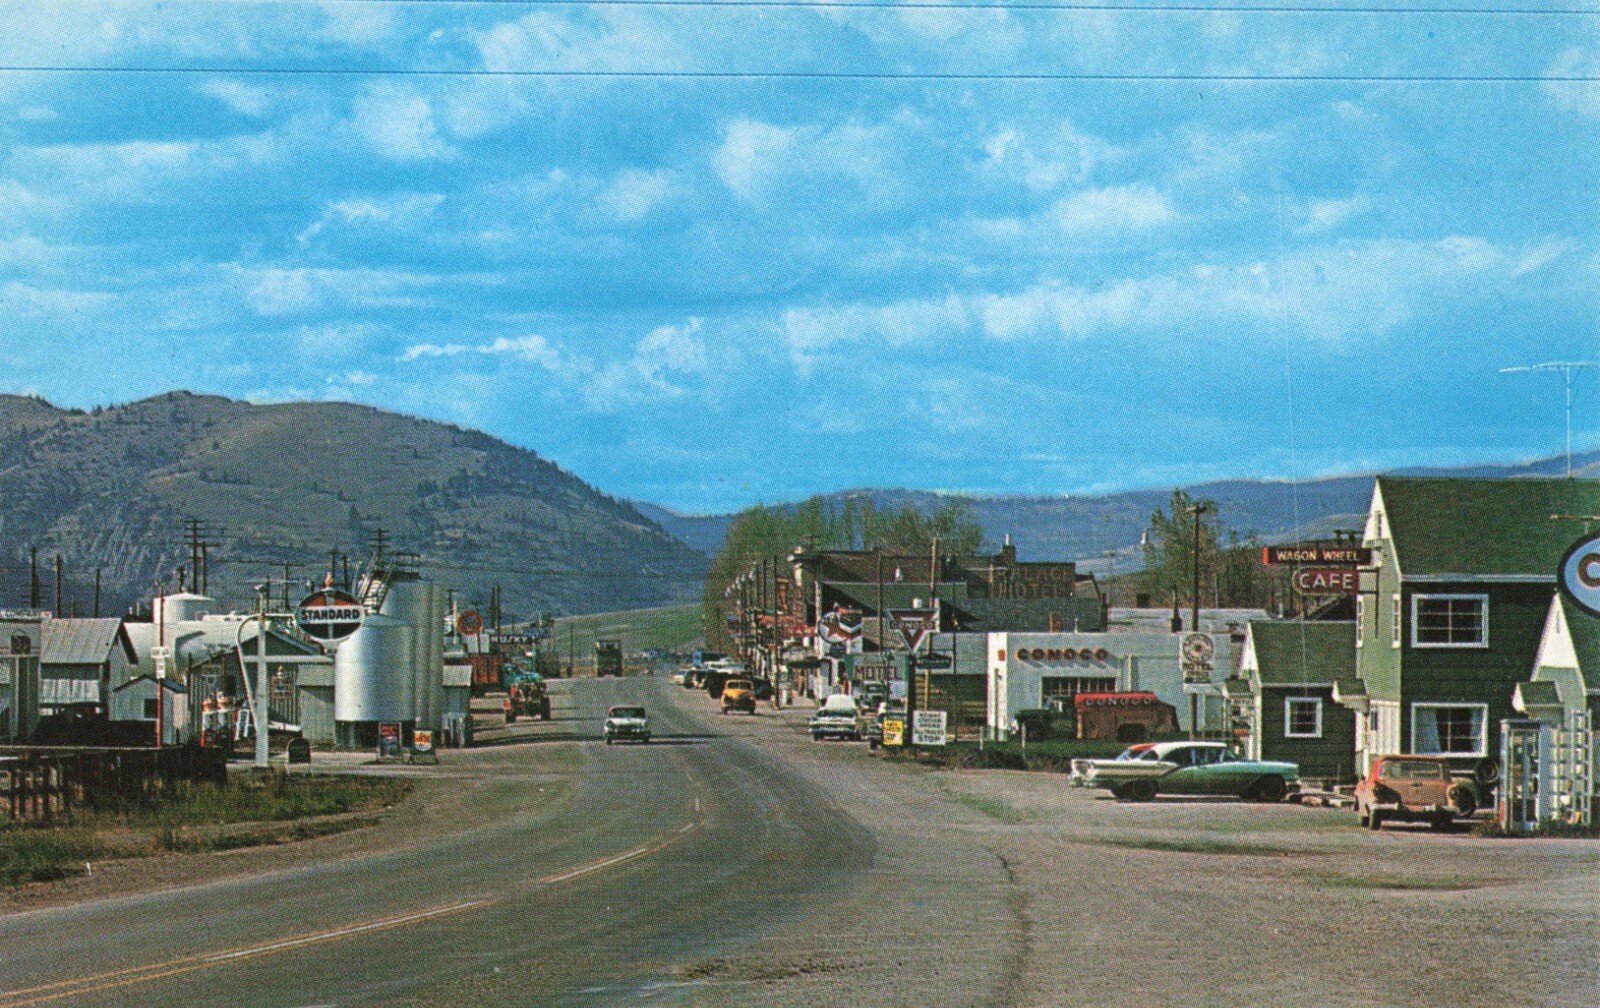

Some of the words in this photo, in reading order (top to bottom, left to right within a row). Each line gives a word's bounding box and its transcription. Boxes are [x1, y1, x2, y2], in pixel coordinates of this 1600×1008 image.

[1275, 549, 1317, 561] WAGON
[1322, 549, 1358, 561] WHEEL
[1299, 573, 1354, 589] CAFE
[300, 608, 361, 620] STANDARD
[890, 620, 935, 630] CONOCO
[1016, 647, 1109, 661] CONOCO
[853, 665, 903, 681] MOTEL
[1084, 697, 1152, 706] CONOCO
